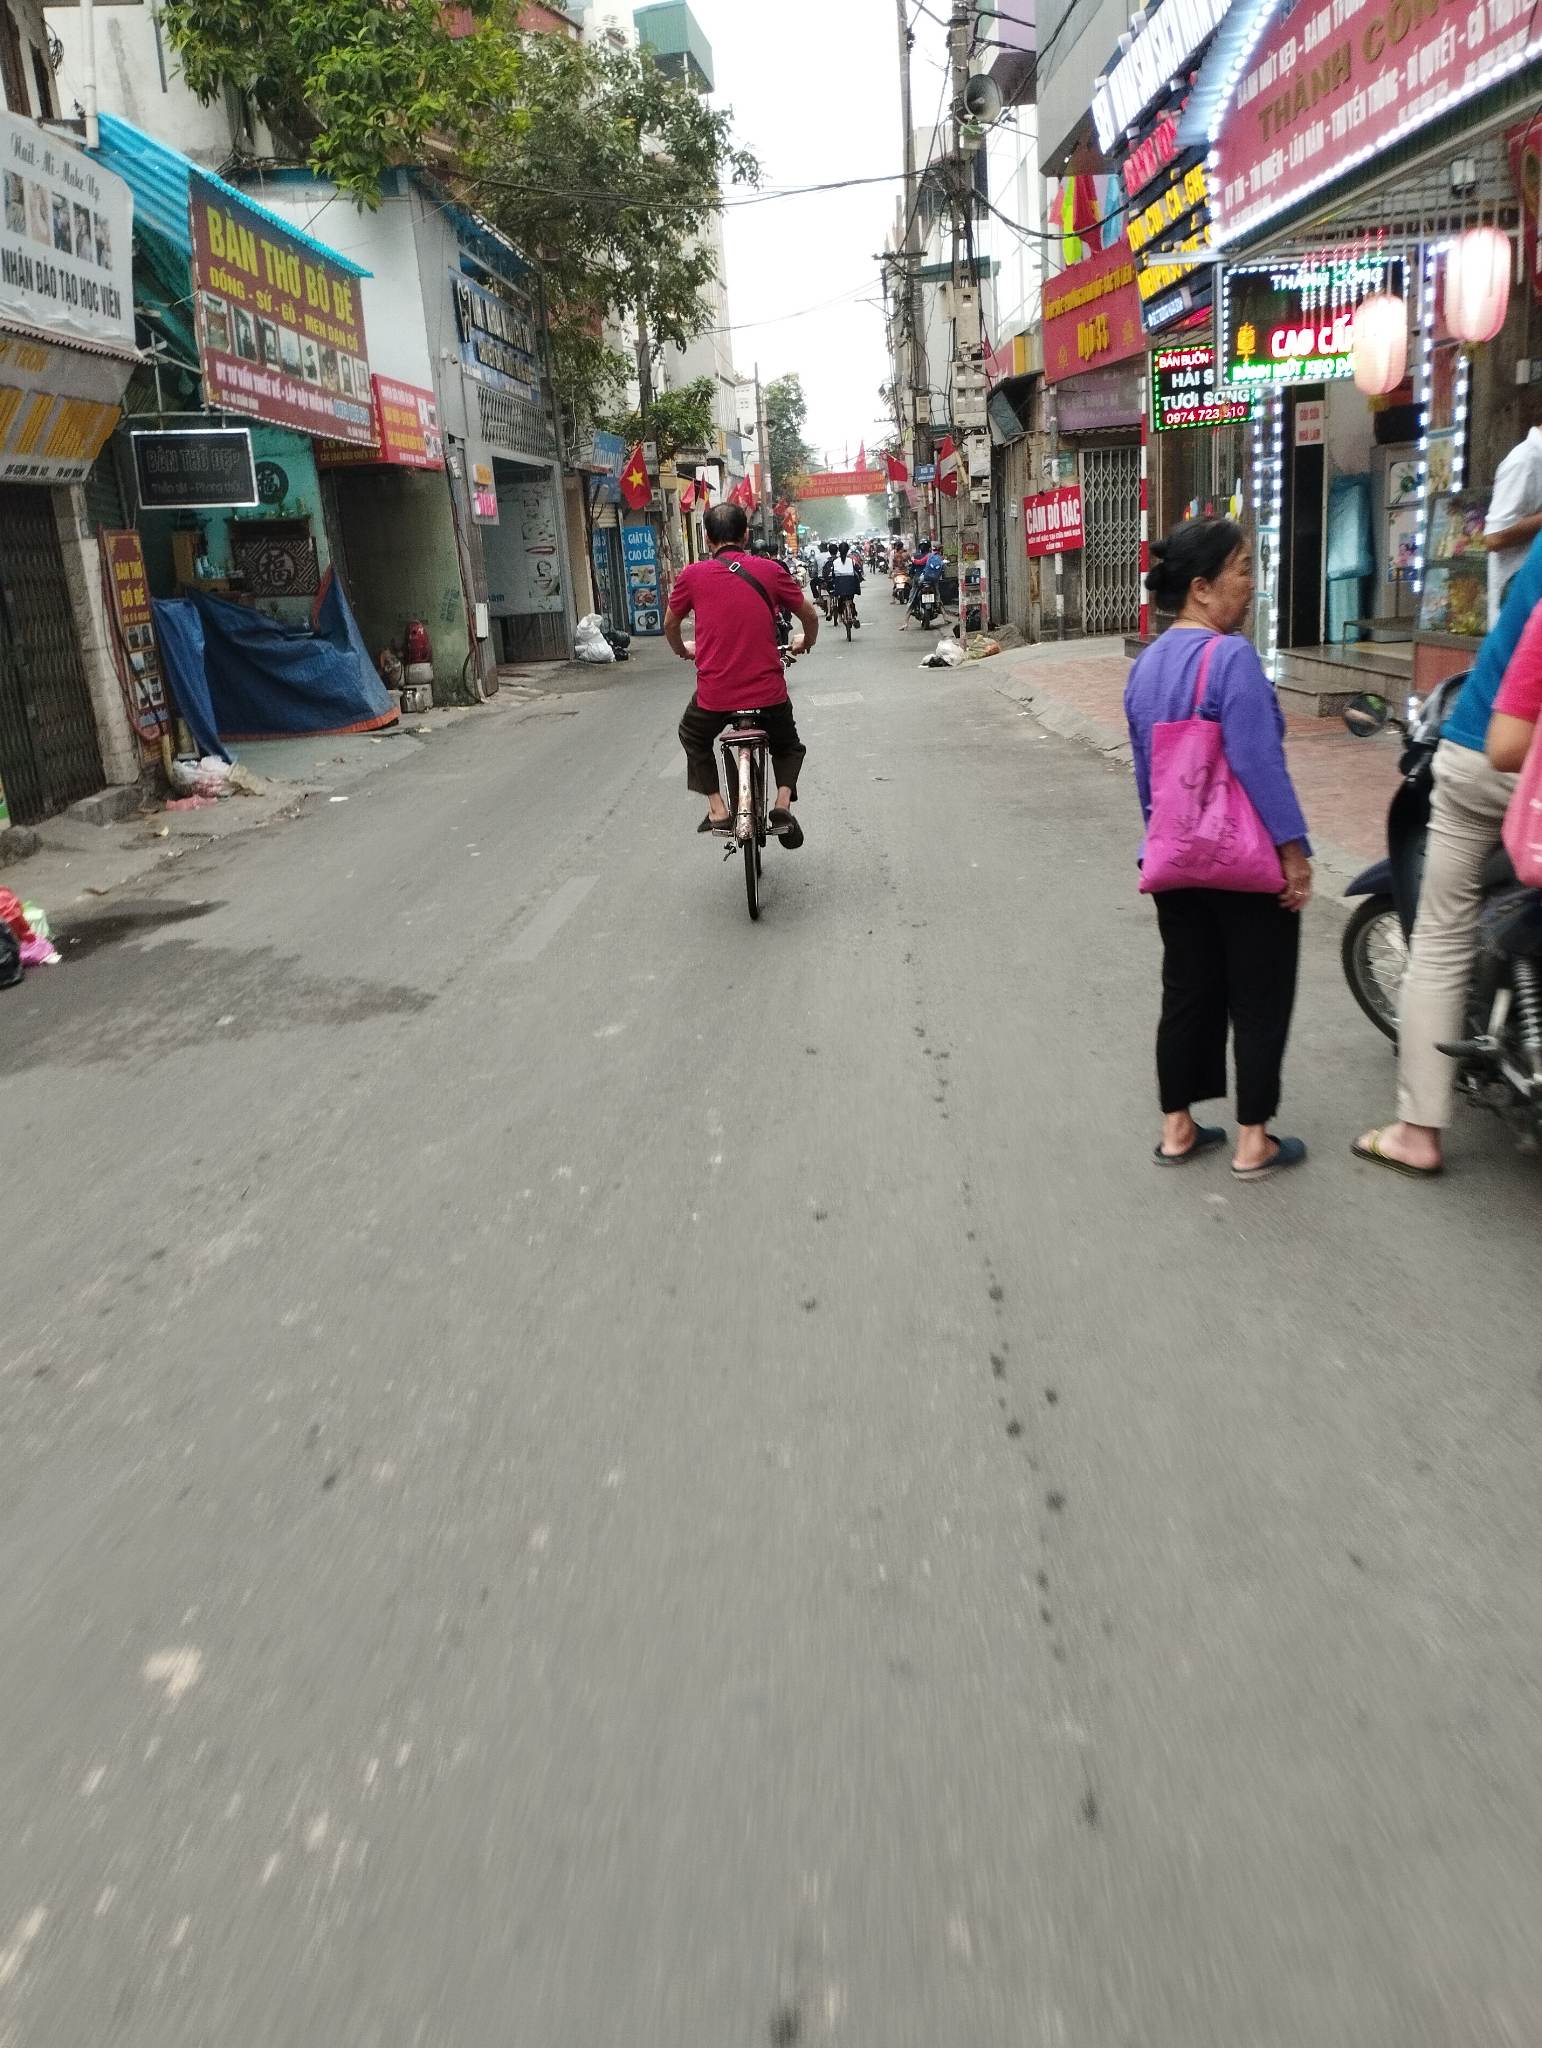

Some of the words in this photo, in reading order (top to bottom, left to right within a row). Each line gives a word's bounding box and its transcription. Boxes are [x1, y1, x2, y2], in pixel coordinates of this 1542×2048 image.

[1258, 39, 1351, 143] THÀNH
[207, 206, 259, 277] BÀN
[261, 244, 302, 299] THỜ
[1271, 328, 1314, 357] CAO
[1318, 313, 1354, 354] CẤ
[1159, 352, 1180, 368] BÁN
[1181, 351, 1209, 366] BUÔN
[1172, 367, 1200, 388] HẢI
[1161, 391, 1199, 411] TƯƠI
[1167, 411, 1195, 424] 0974
[1198, 409, 1219, 420] 723
[1026, 498, 1046, 534] CẤM
[1047, 492, 1060, 530] ĐỔ
[1061, 494, 1080, 527] RÁC
[628, 550, 641, 561] CAO
[643, 547, 656, 560] CẤP
